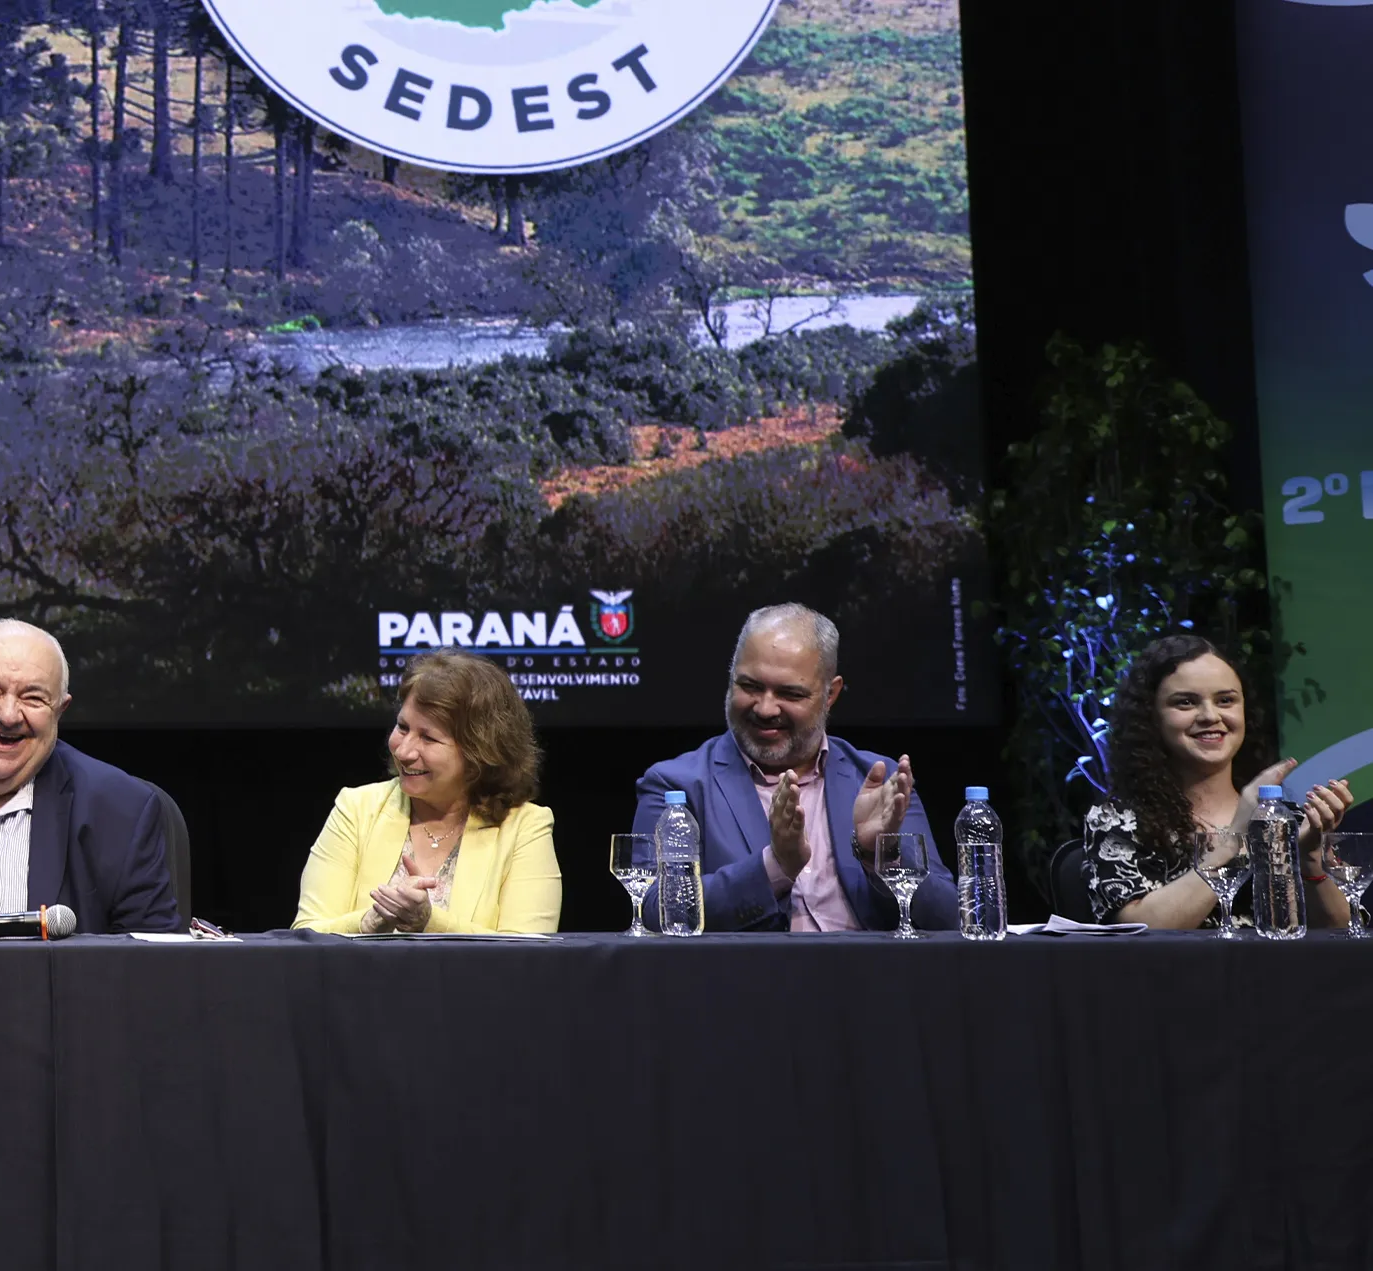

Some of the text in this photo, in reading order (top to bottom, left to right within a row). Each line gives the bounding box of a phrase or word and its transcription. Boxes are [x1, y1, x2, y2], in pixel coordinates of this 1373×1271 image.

[328, 43, 658, 133] SEDEST
[378, 605, 586, 647] PARANÁ
[552, 656, 641, 668] ESTADO
[510, 673, 640, 685] ESENVOLVIMENTO
